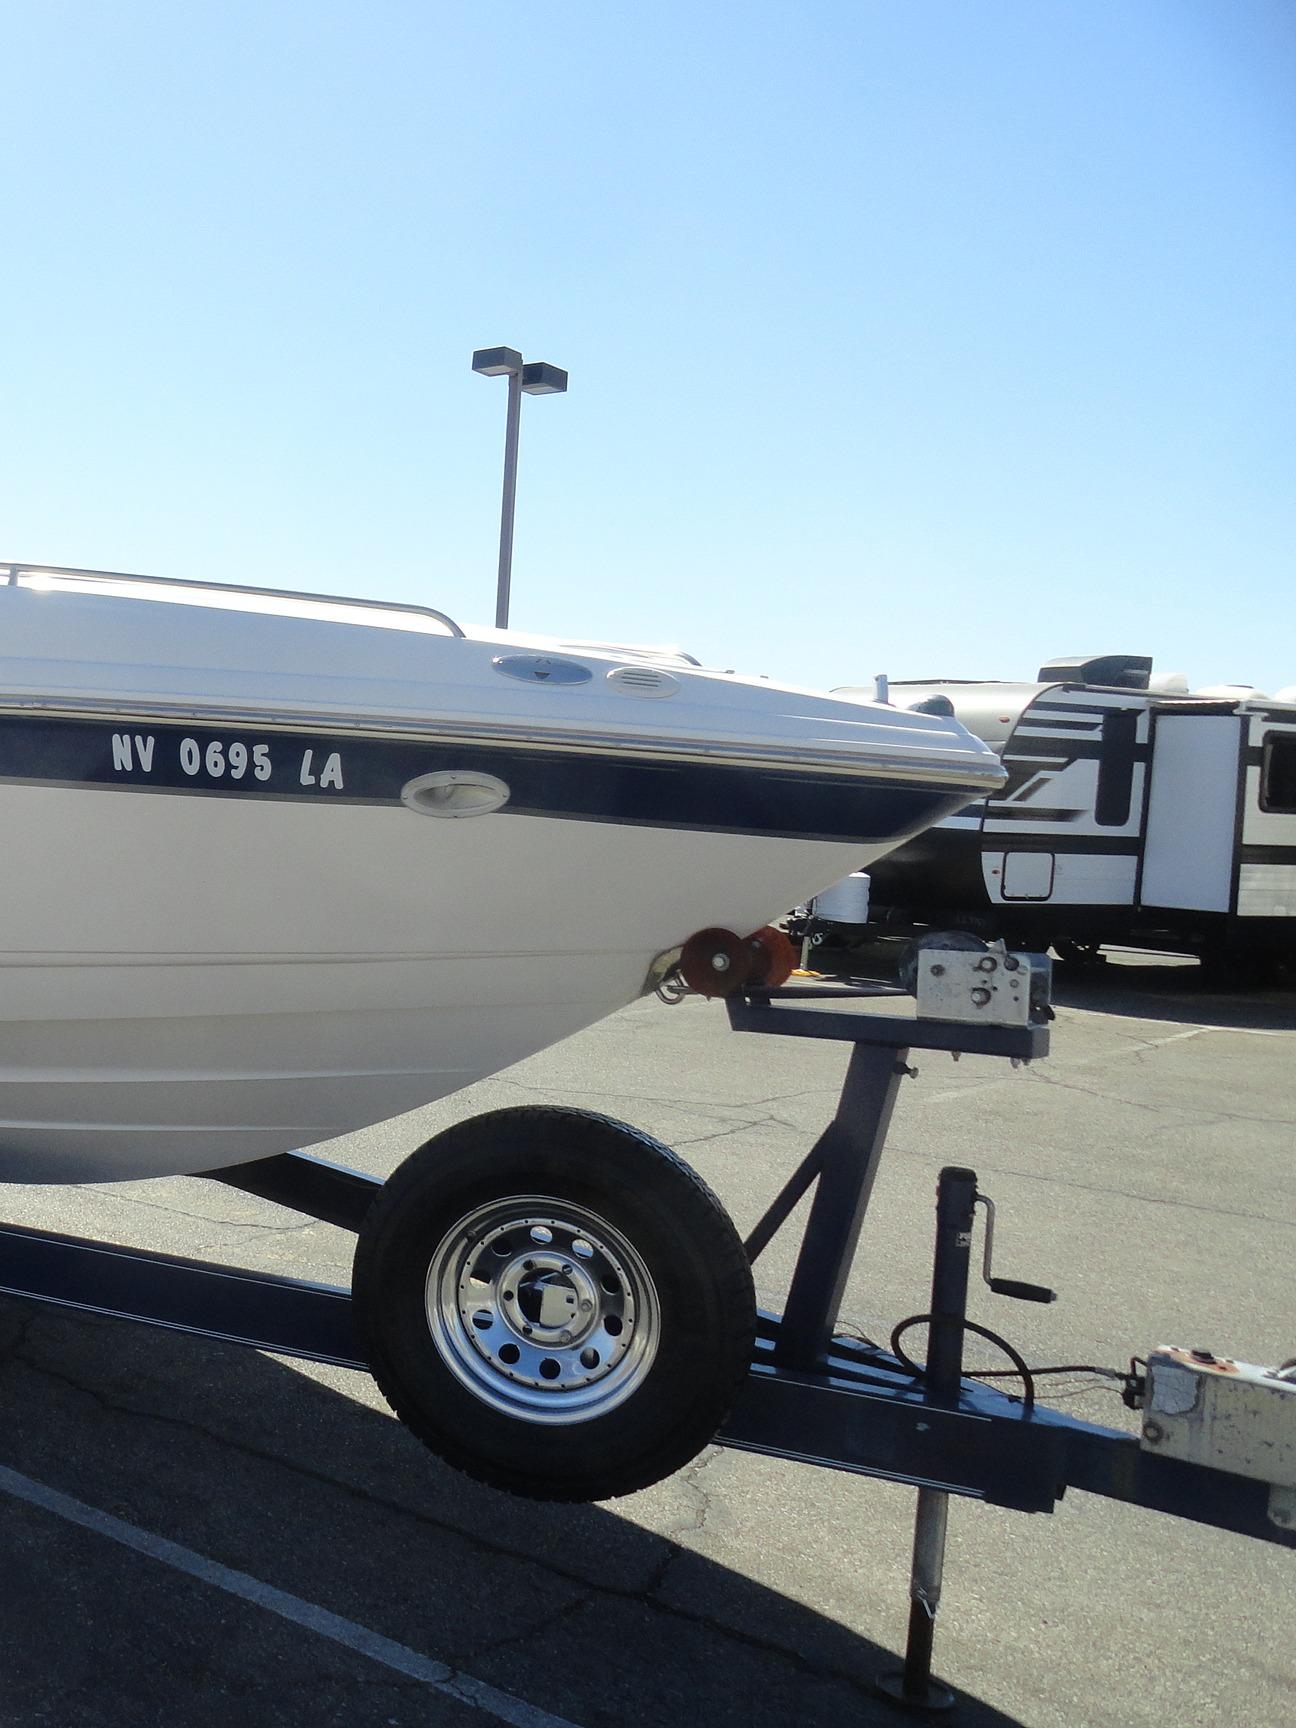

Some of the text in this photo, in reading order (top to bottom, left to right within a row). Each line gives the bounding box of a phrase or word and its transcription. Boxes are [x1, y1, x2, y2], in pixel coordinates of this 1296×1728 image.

[111, 733, 344, 790] NV 0695 LA
